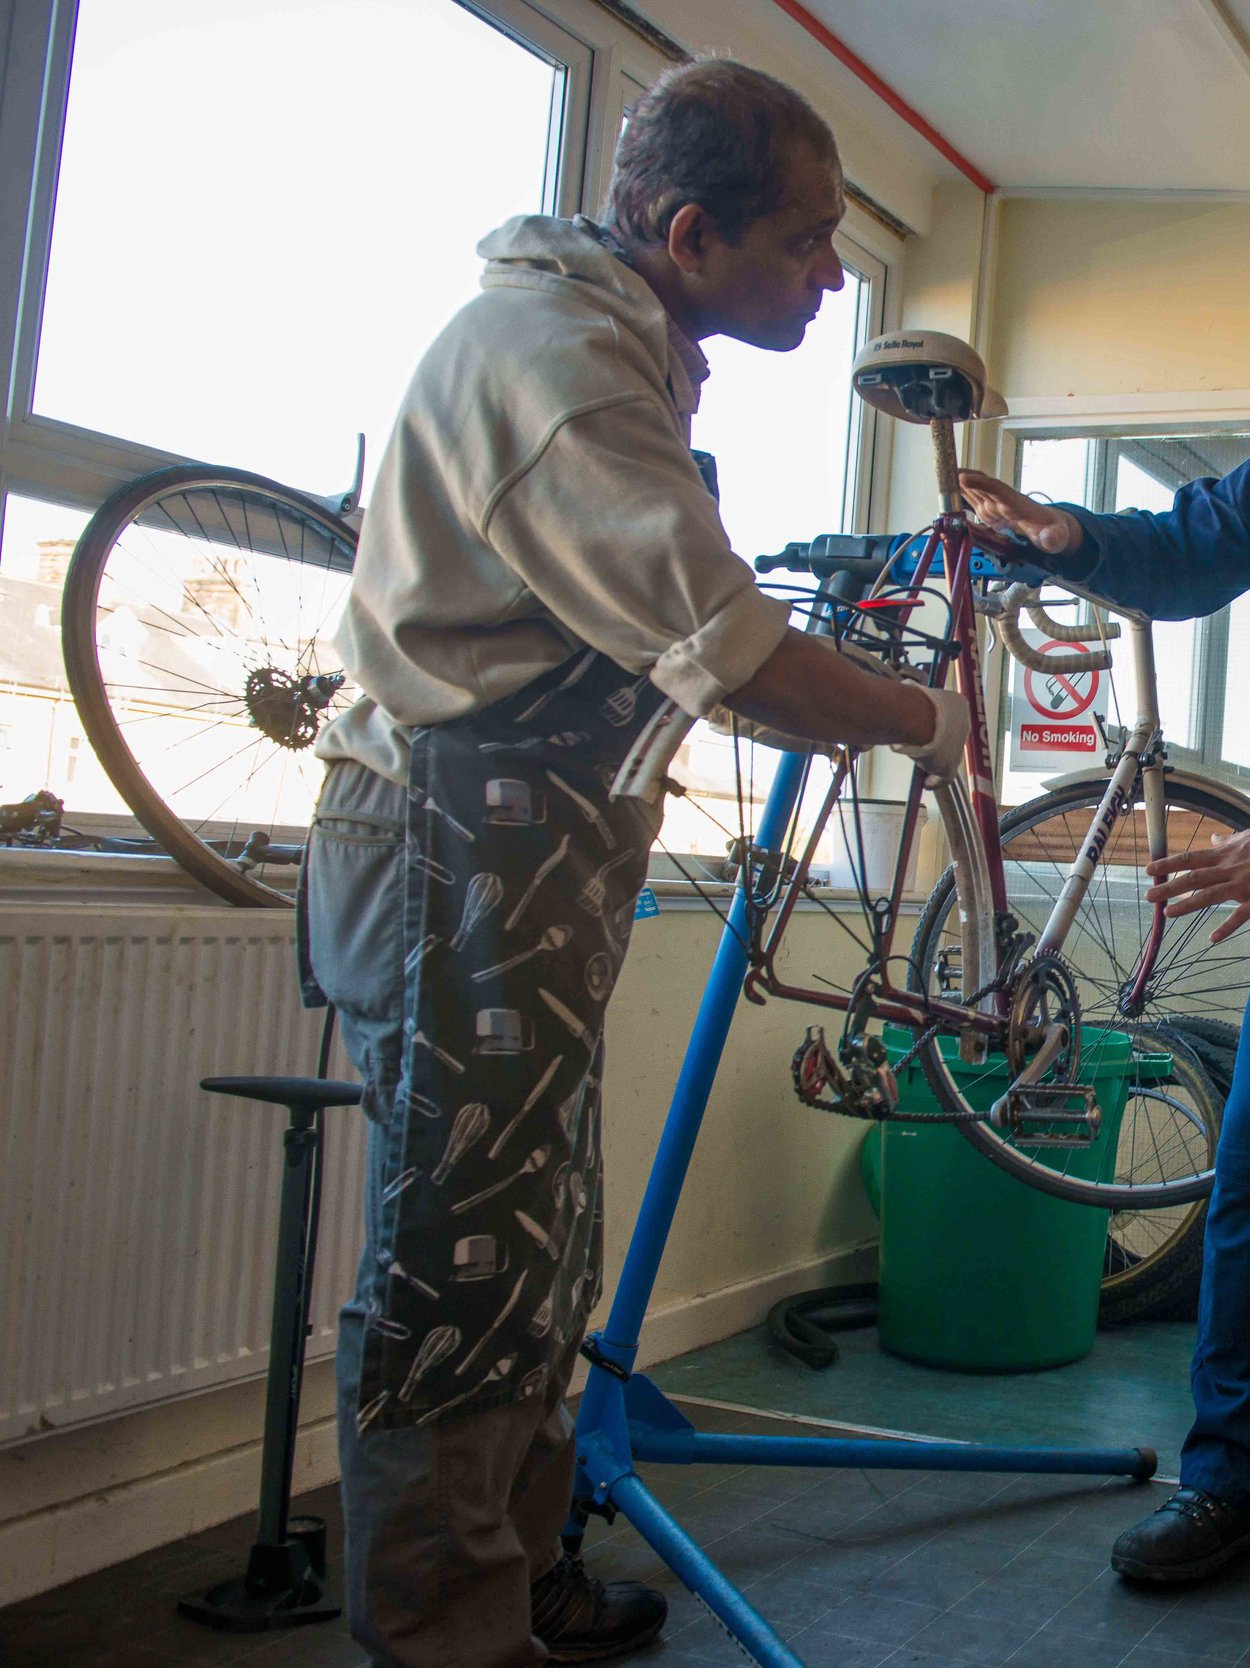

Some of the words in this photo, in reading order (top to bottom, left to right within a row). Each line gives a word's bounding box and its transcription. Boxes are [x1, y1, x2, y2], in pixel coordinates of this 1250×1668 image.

[901, 339, 924, 350] Royal
[1022, 730, 1040, 742] No
[1042, 730, 1095, 746] Smoking
